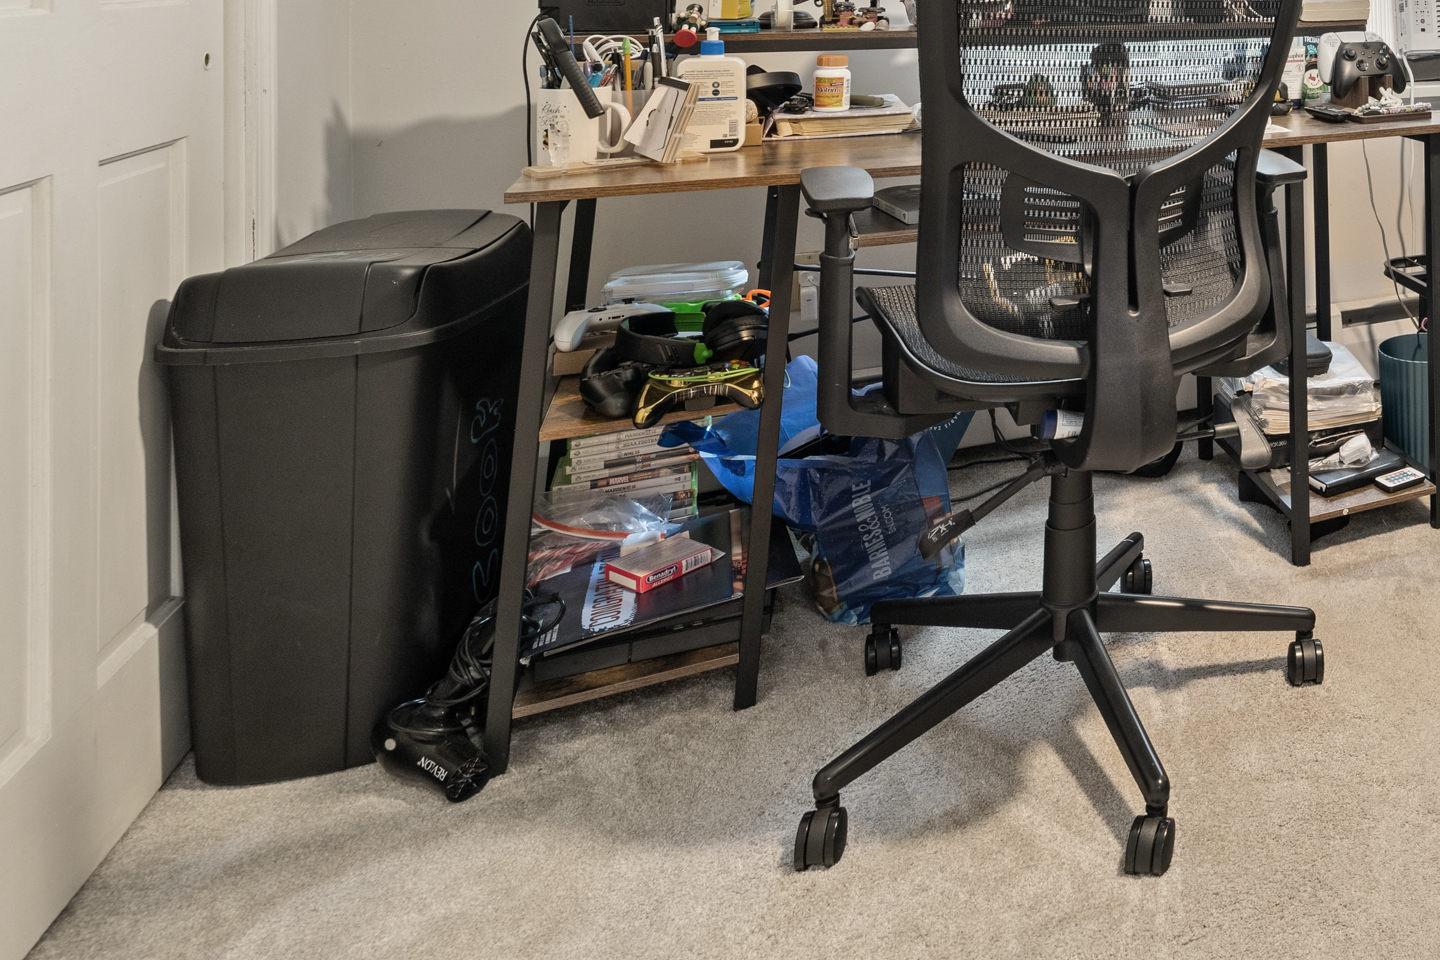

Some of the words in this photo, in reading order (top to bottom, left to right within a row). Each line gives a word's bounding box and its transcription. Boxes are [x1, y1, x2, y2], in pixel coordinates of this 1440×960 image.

[609, 475, 630, 486] MARVEL
[648, 564, 677, 583] Benadryl
[652, 575, 674, 588] ALLERGY
[417, 755, 449, 782] REVLON
